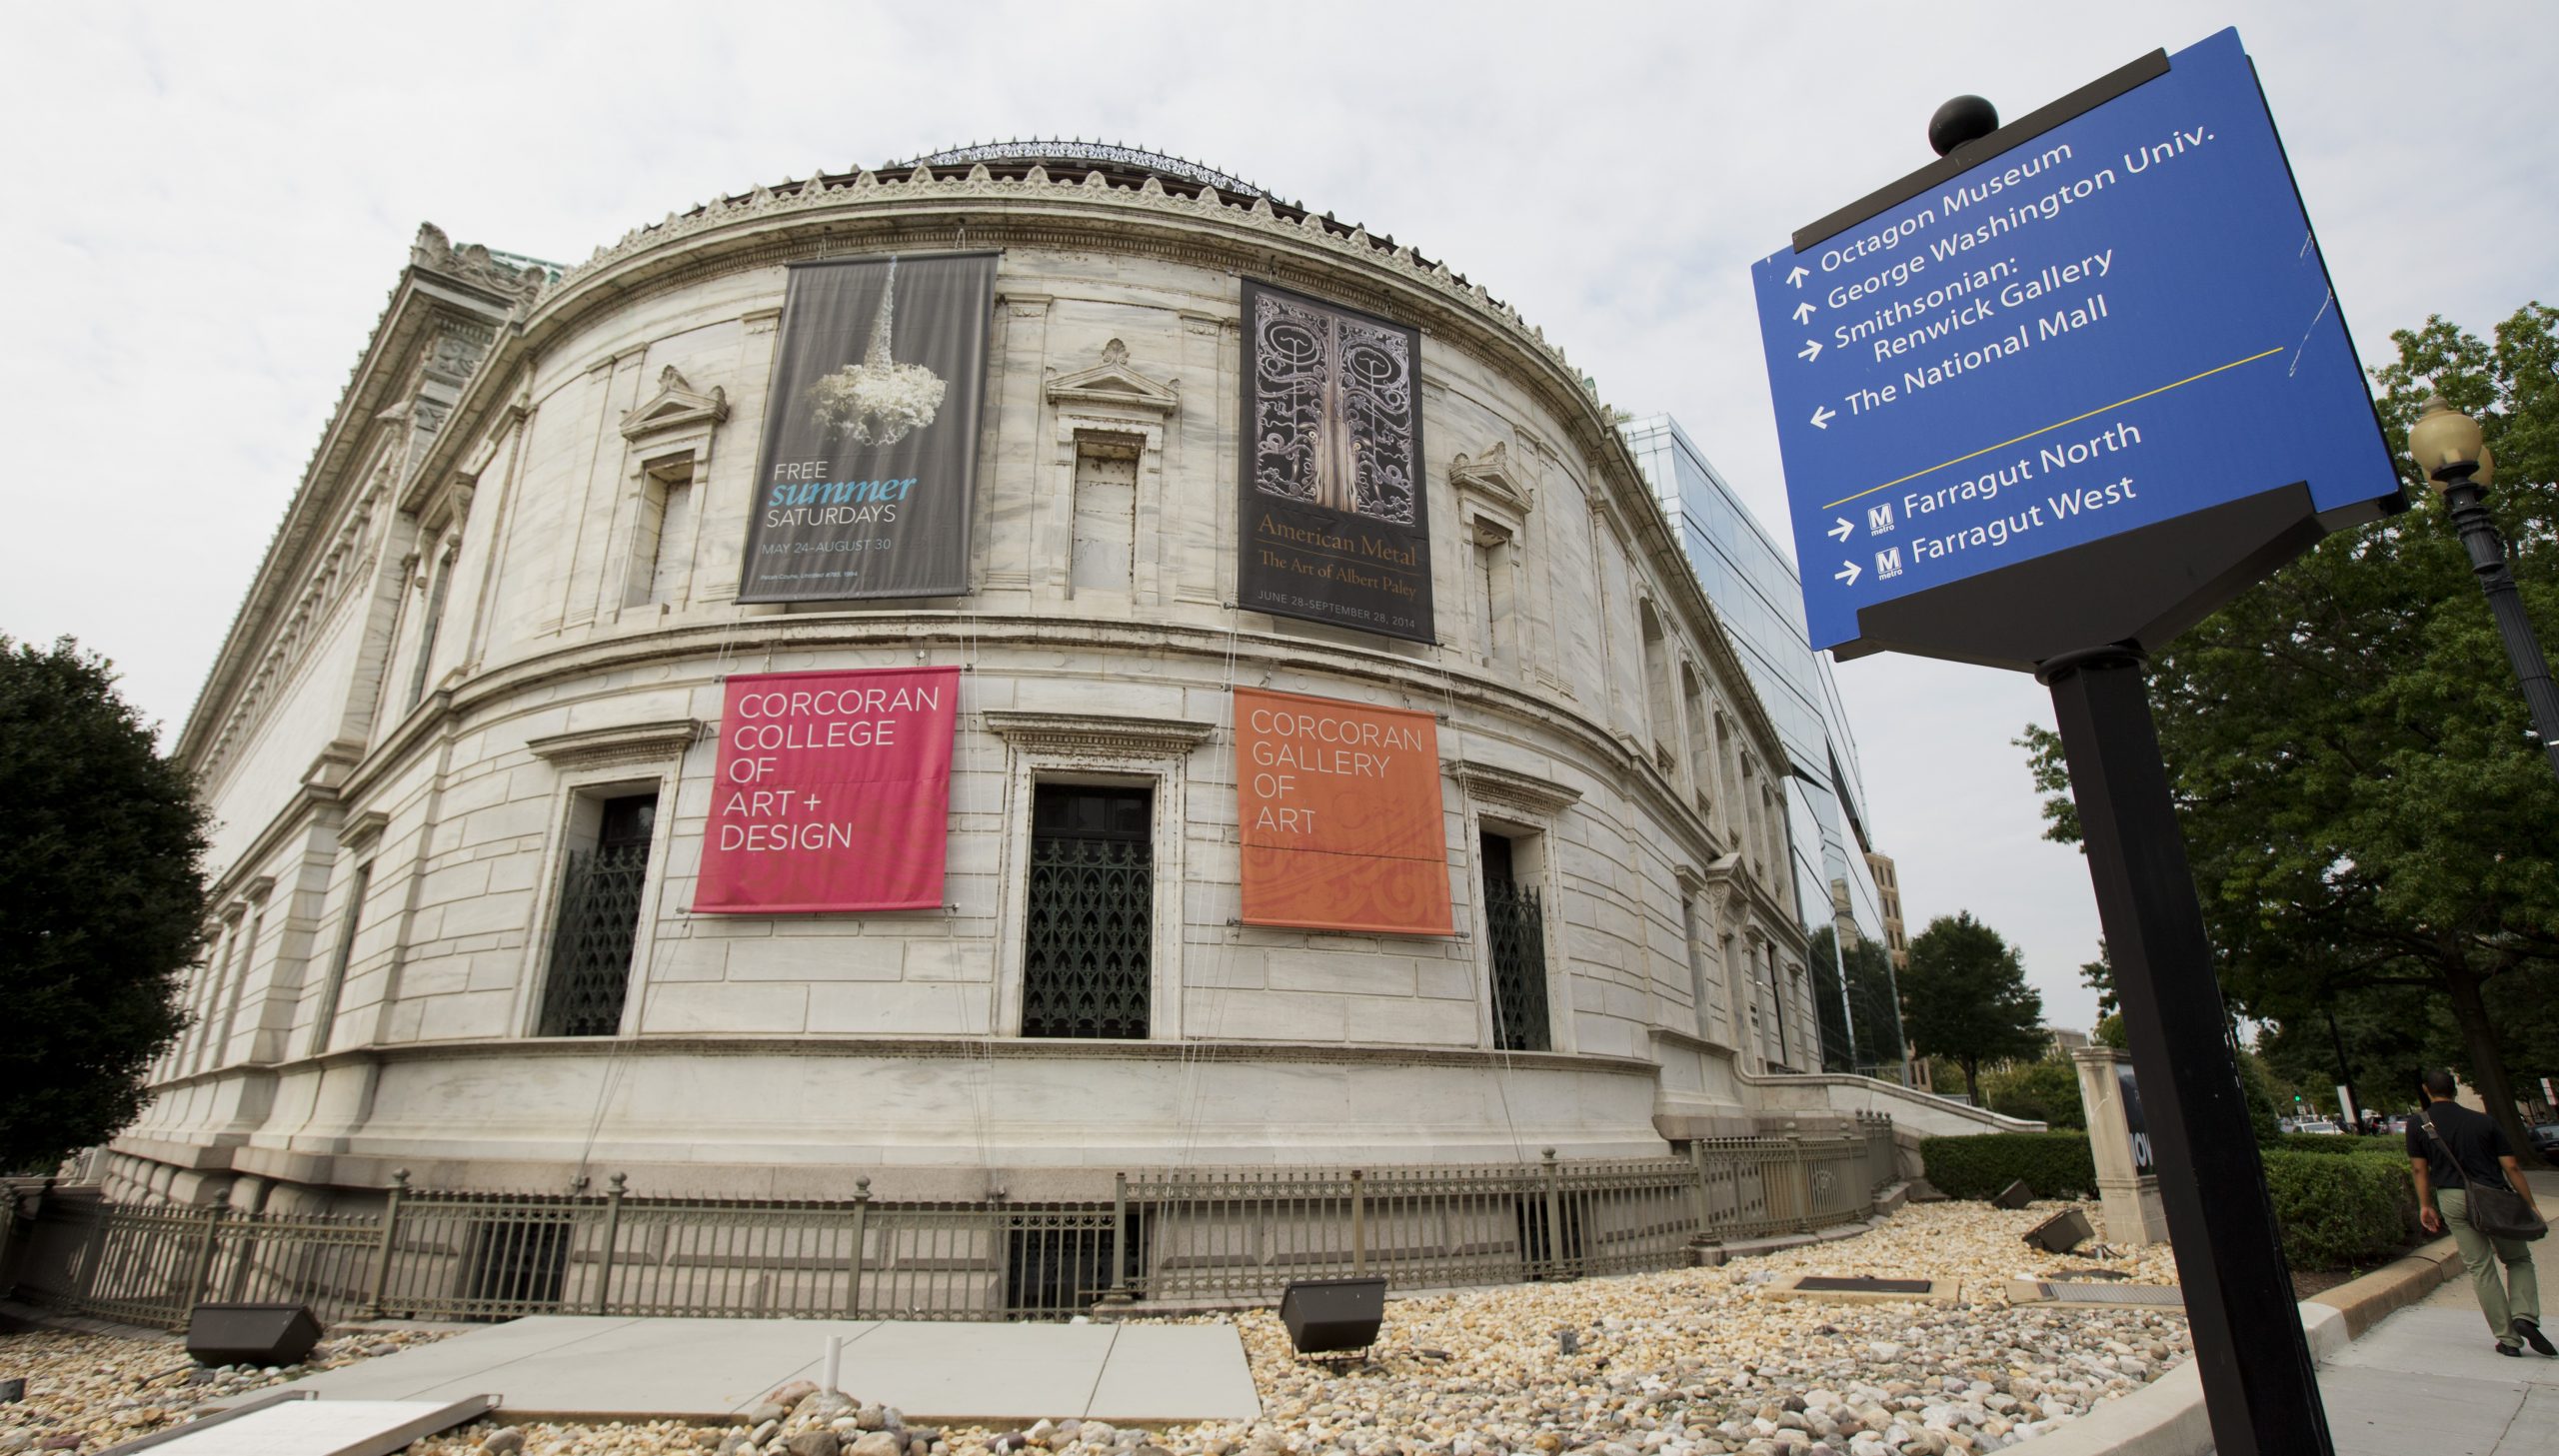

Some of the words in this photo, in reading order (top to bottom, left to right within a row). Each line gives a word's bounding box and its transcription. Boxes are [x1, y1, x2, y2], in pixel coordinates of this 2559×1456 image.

[1821, 208, 1935, 273] Octagon
[1942, 143, 2072, 217] Museum
[1827, 255, 1925, 310] George
[1930, 168, 2116, 263] Washington
[2123, 126, 2215, 175] Univ.
[1833, 256, 2018, 349] Smithsonian:
[1873, 297, 1995, 363] Renwick
[2000, 249, 2113, 309] Gallery
[1845, 385, 1897, 416] The
[1903, 325, 2029, 394] National
[2039, 294, 2108, 342] Mall
[774, 461, 830, 482] FREE
[1903, 458, 2033, 519] Farragut
[2040, 422, 2142, 474] North
[767, 477, 918, 507] summer
[766, 504, 897, 528] SATURDAYS
[1868, 504, 1892, 529] M
[1870, 524, 1895, 537] metro
[1911, 504, 2044, 564] Farragut
[2047, 476, 2137, 521] West
[761, 543, 791, 555] MAY
[875, 538, 892, 552] 30
[1258, 513, 1354, 553] American
[1360, 534, 1416, 567] Metal
[1261, 550, 1287, 569] The
[1290, 558, 1314, 577] Art
[1317, 564, 1334, 579] of
[1335, 567, 1378, 589] Albert
[1382, 576, 1416, 601] Paley
[1876, 548, 1901, 573] M
[1878, 569, 1903, 581] metro
[1258, 590, 1287, 605] JUNE
[1391, 616, 1415, 630] 2014
[738, 686, 940, 720] CORCORAN
[734, 720, 897, 750] COLLEGE
[1251, 709, 1422, 752] CORCORAN
[729, 756, 778, 783] OF
[1253, 740, 1390, 778] GALLERY
[1254, 772, 1296, 799] OF
[723, 789, 796, 817] ART
[1256, 805, 1316, 834] ART
[720, 822, 853, 851] DESIGN
